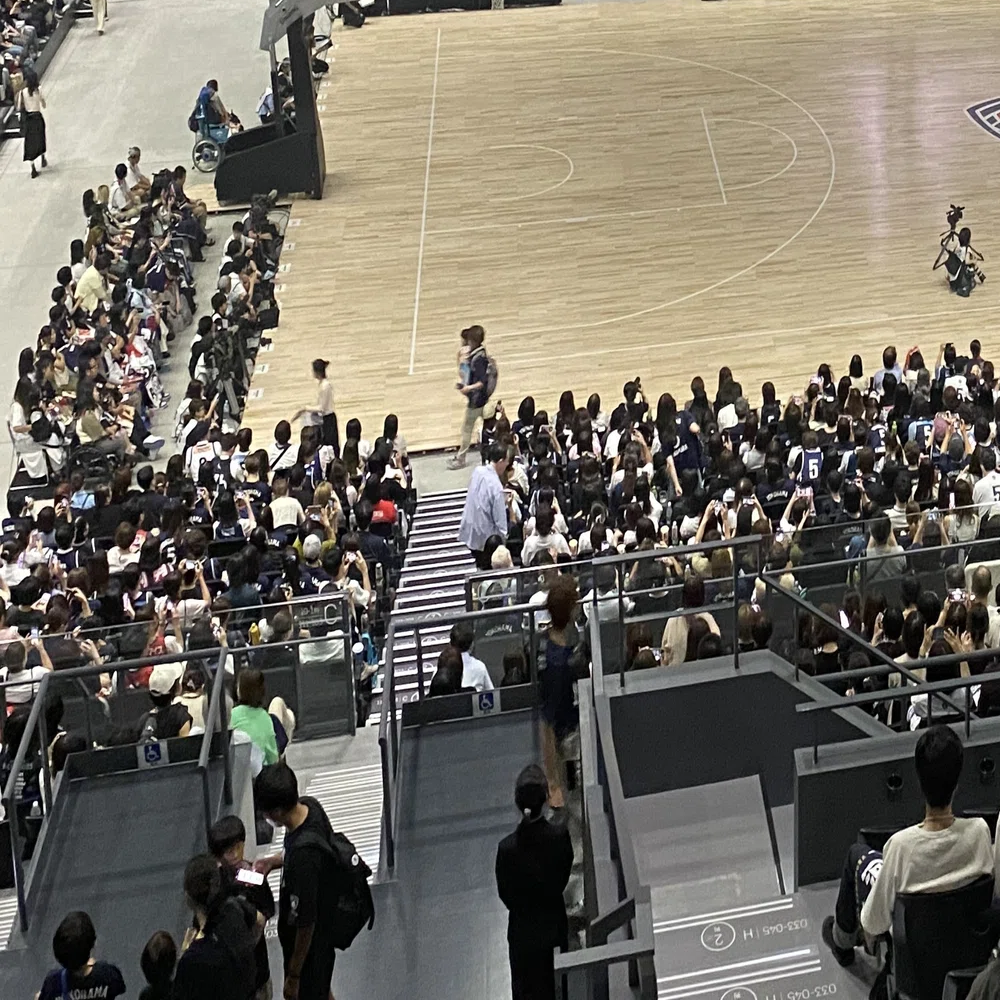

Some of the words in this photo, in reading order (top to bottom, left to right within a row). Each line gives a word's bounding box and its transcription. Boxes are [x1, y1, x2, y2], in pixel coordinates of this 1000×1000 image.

[808, 458, 819, 479] 5
[324, 603, 337, 625] C
[743, 930, 754, 941] H
[762, 918, 808, 937] 033-045
[713, 933, 724, 947] 2
